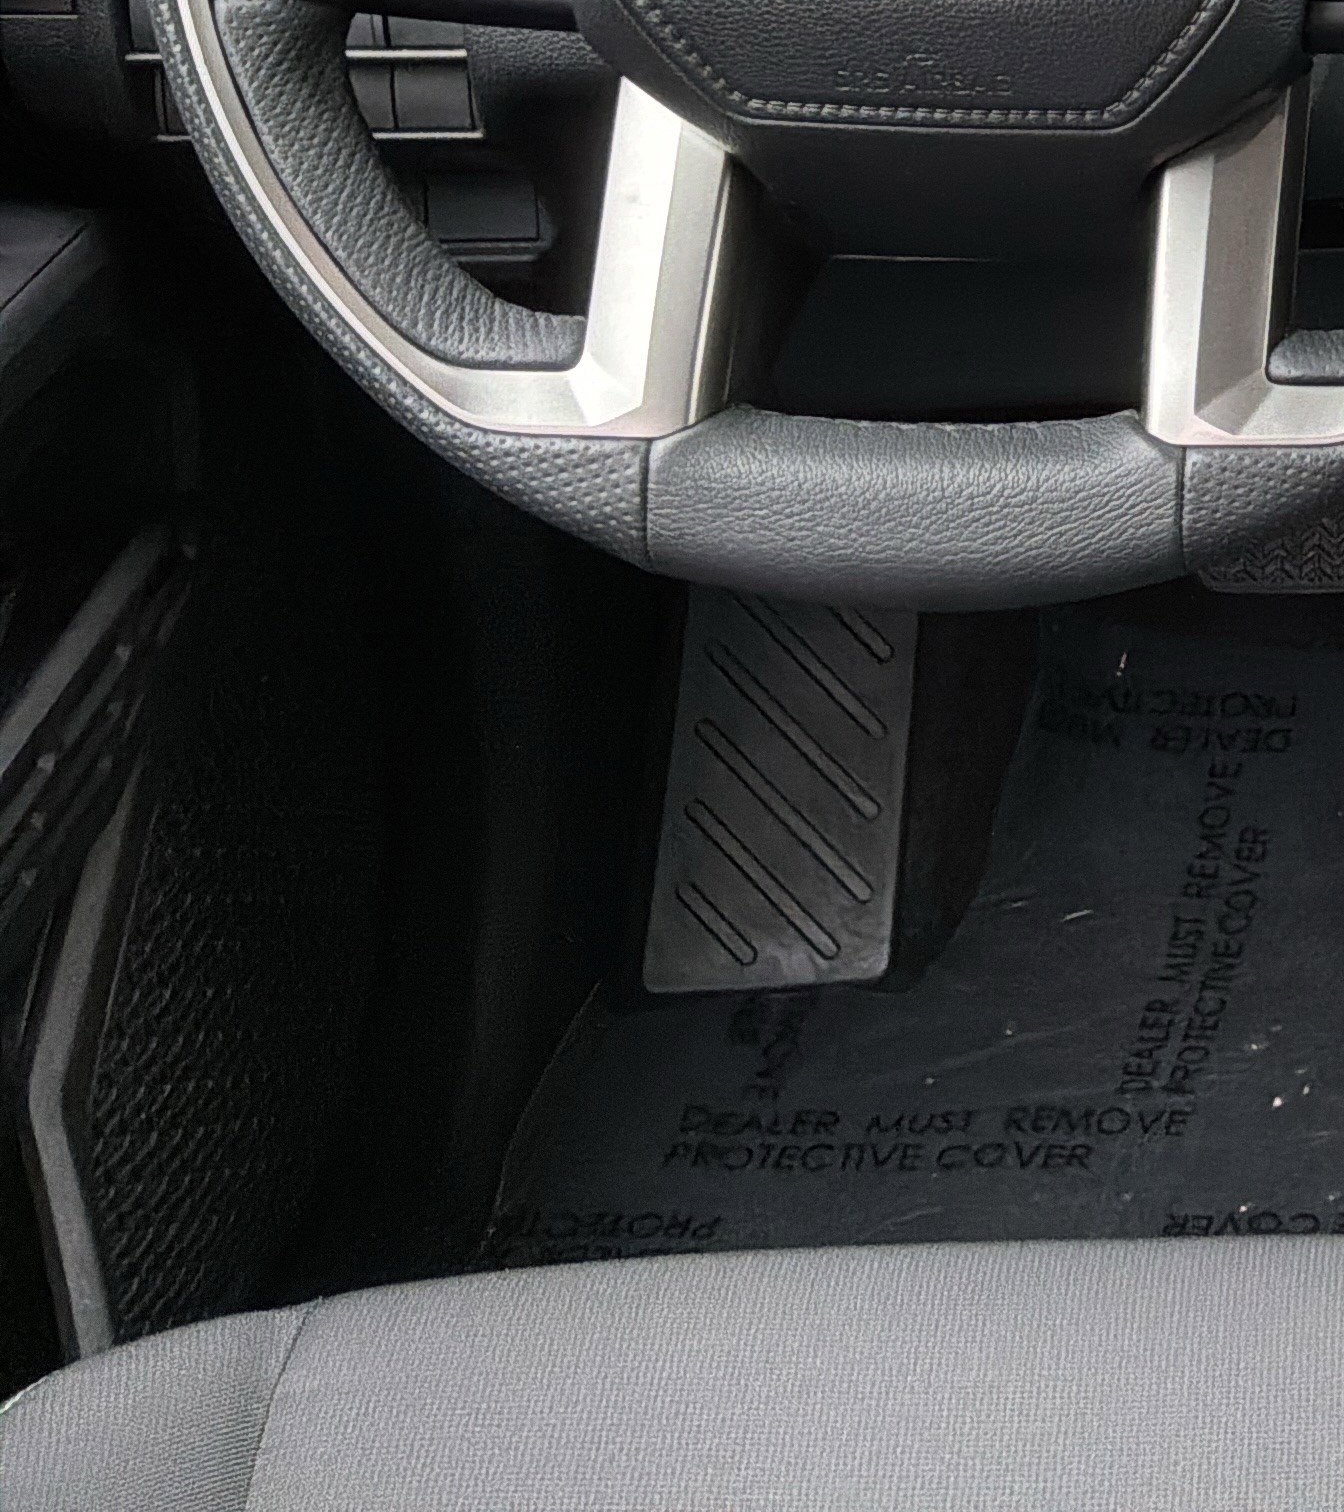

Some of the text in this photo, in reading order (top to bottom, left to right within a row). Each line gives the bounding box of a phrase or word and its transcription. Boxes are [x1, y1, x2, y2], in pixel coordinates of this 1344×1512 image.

[1116, 761, 1243, 1094] DEALER MUST REMOVE
[1162, 825, 1270, 1095] PROTECTIVE COVER
[662, 1141, 1096, 1171] PROTECTIVE COVER
[679, 1104, 1197, 1138] DEALER MUST REMOVE
